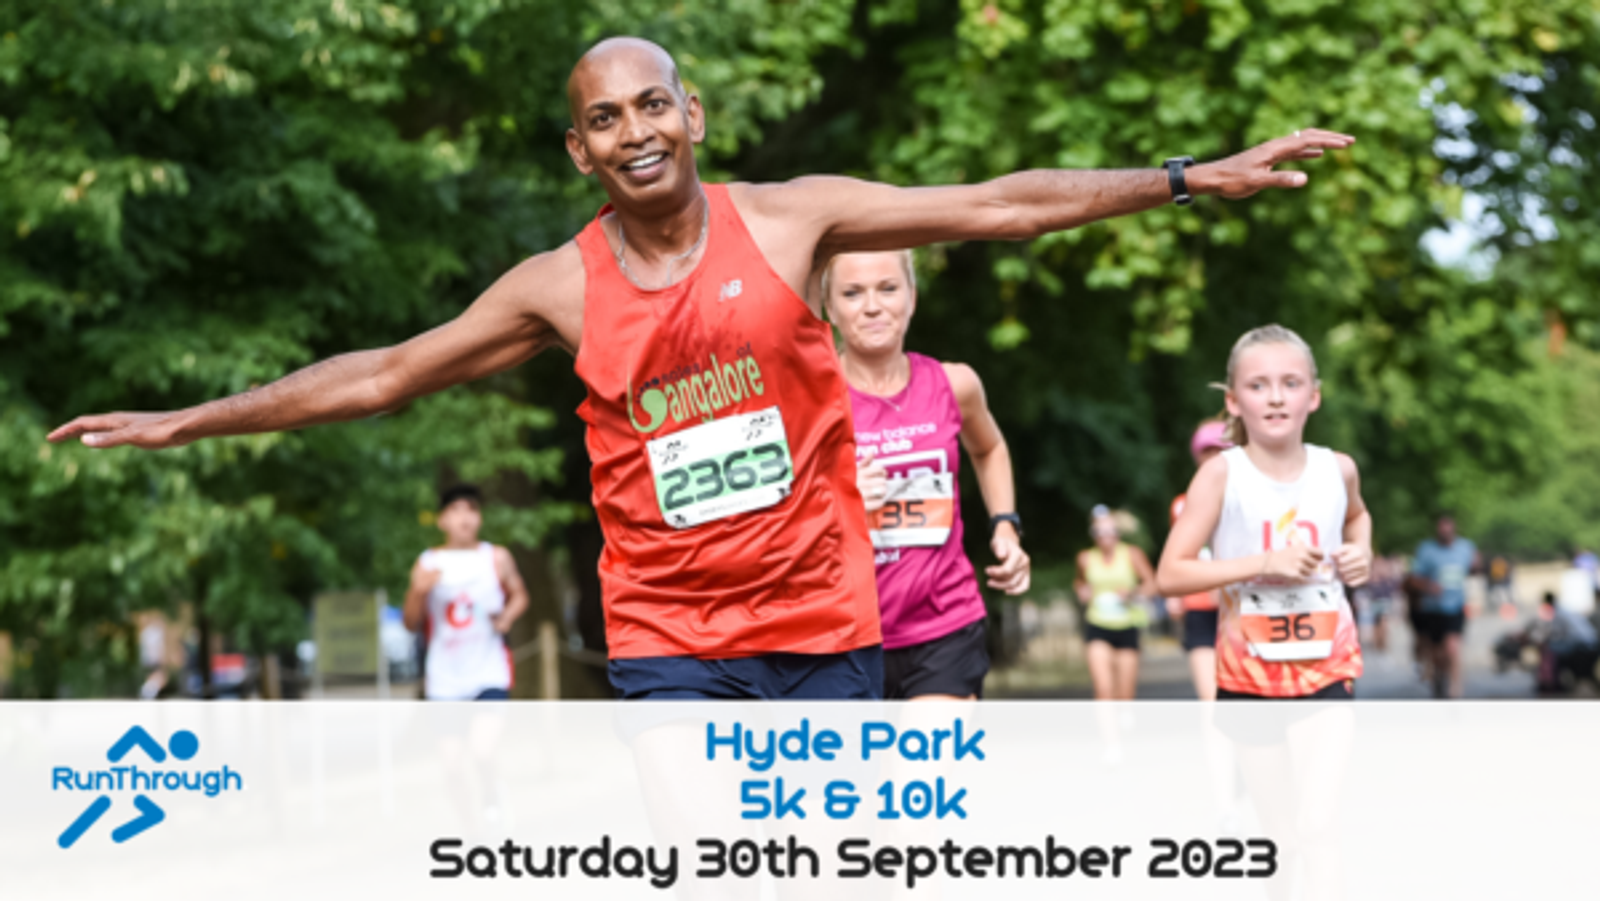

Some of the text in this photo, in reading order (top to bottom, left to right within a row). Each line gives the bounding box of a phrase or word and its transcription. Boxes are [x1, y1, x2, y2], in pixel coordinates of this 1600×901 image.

[881, 438, 913, 454] club
[661, 443, 788, 511] 2363
[880, 499, 927, 530] 35
[1268, 612, 1316, 643] 36
